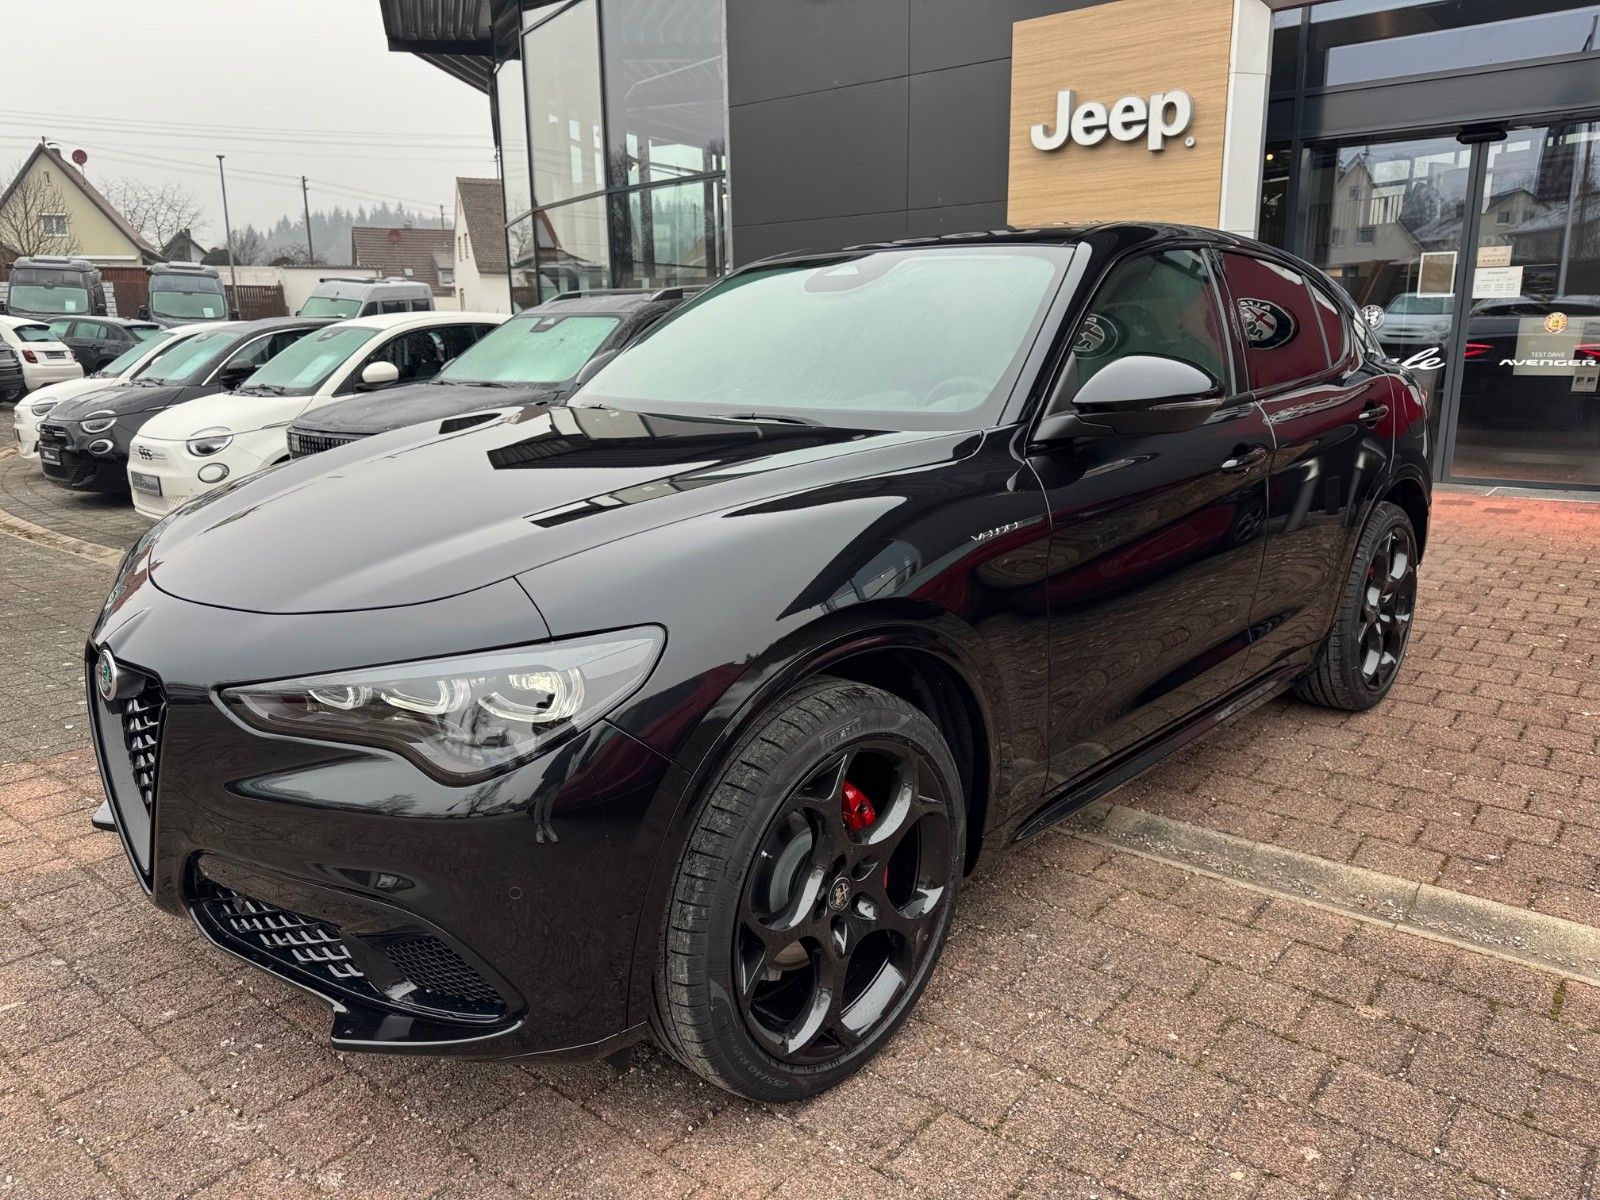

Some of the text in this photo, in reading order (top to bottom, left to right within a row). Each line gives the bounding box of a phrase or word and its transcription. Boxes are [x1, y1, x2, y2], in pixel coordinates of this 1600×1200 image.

[1030, 88, 1195, 151] Jeep
[1390, 347, 1447, 370] le
[1499, 359, 1597, 367] AVENGER
